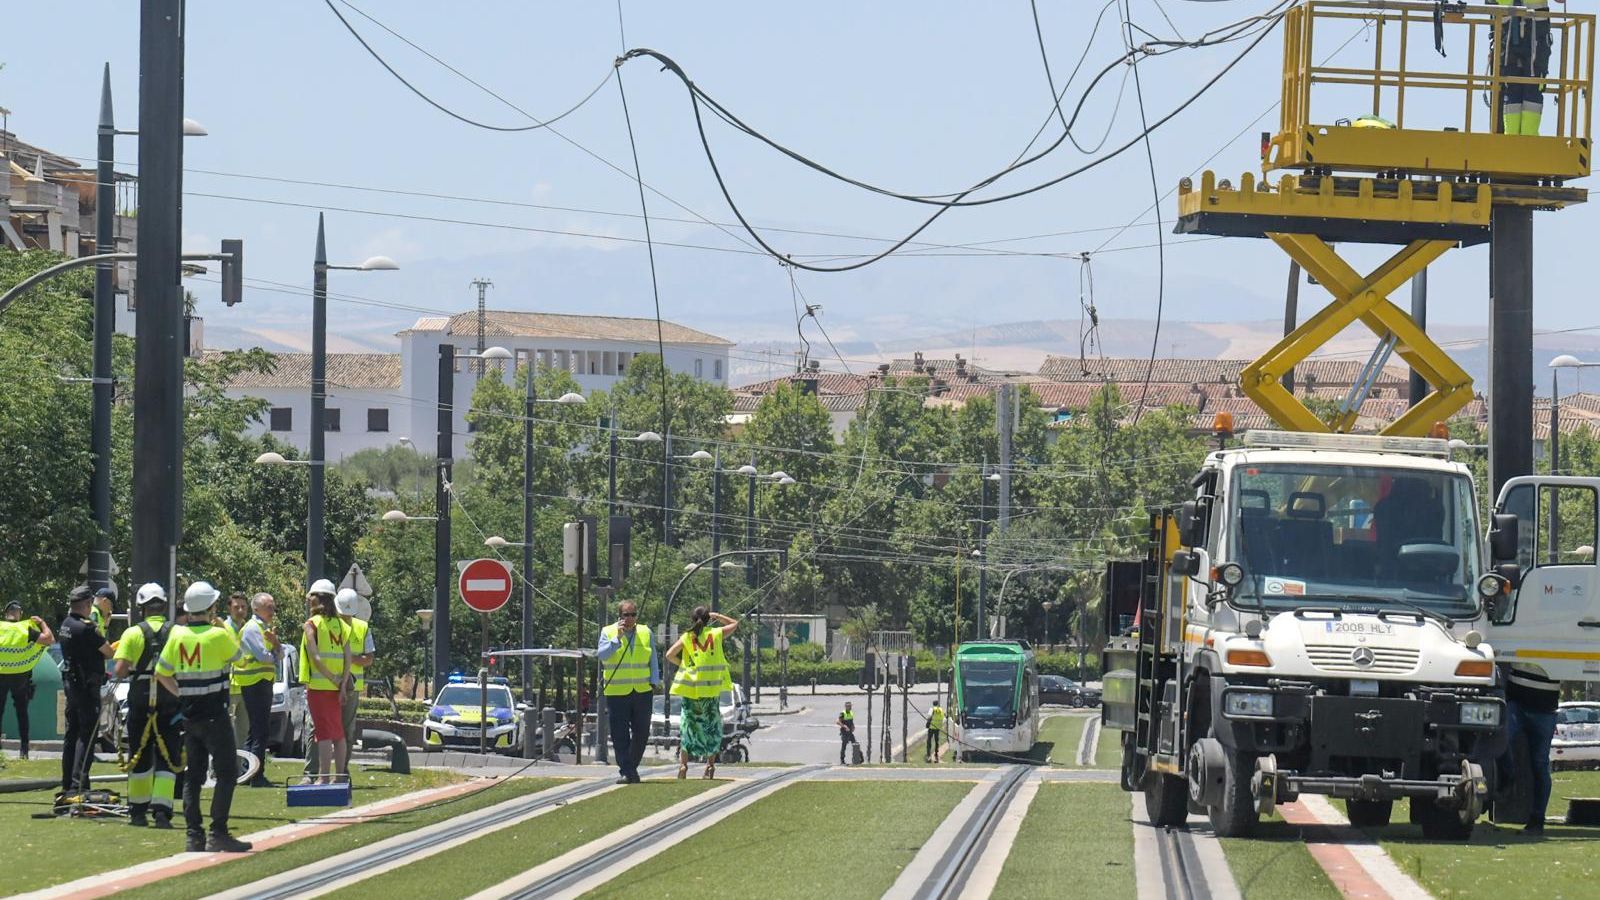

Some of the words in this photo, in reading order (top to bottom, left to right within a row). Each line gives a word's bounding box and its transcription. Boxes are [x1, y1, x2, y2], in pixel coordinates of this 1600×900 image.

[1545, 585, 1553, 596] M
[1335, 622, 1365, 633] 2008
[1371, 624, 1392, 634] HLY
[692, 633, 714, 654] M
[180, 643, 201, 668] M
